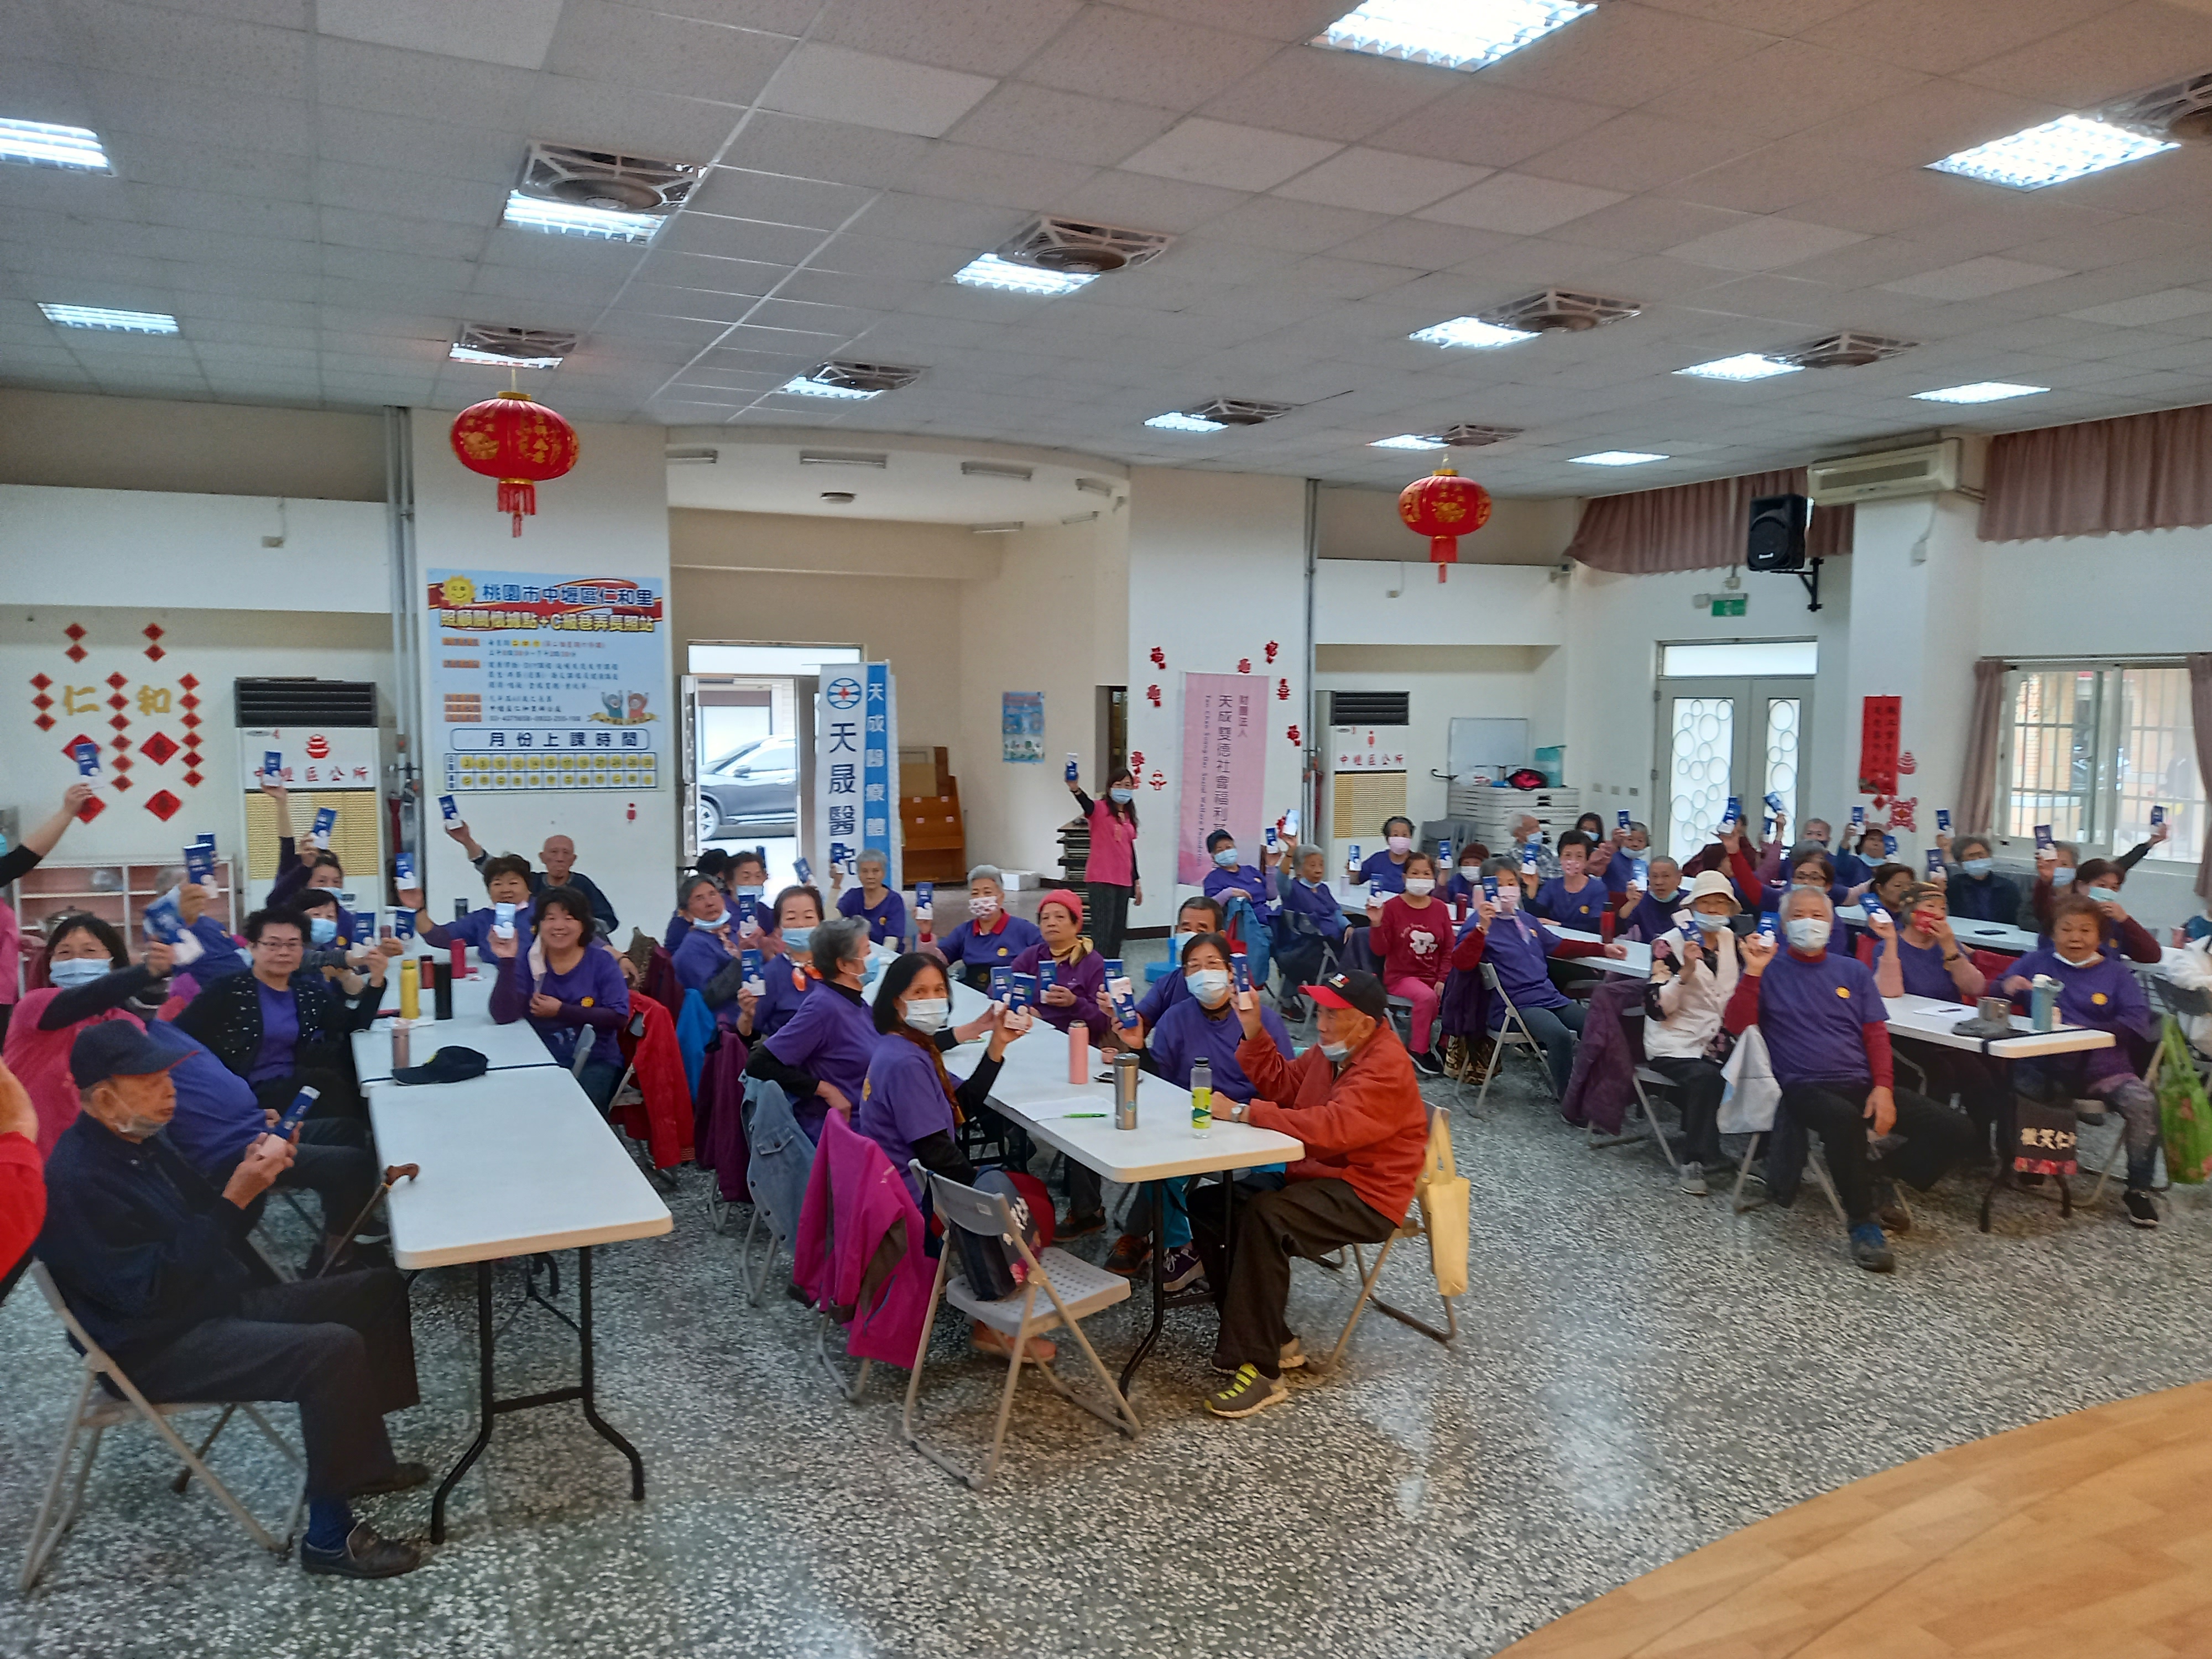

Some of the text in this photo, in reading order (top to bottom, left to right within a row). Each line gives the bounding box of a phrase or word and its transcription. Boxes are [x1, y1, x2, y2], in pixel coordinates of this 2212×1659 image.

[482, 583, 653, 606] 桃園市中壢區仁和里
[64, 685, 171, 716] 仁和
[489, 732, 637, 747] 月份上課時間
